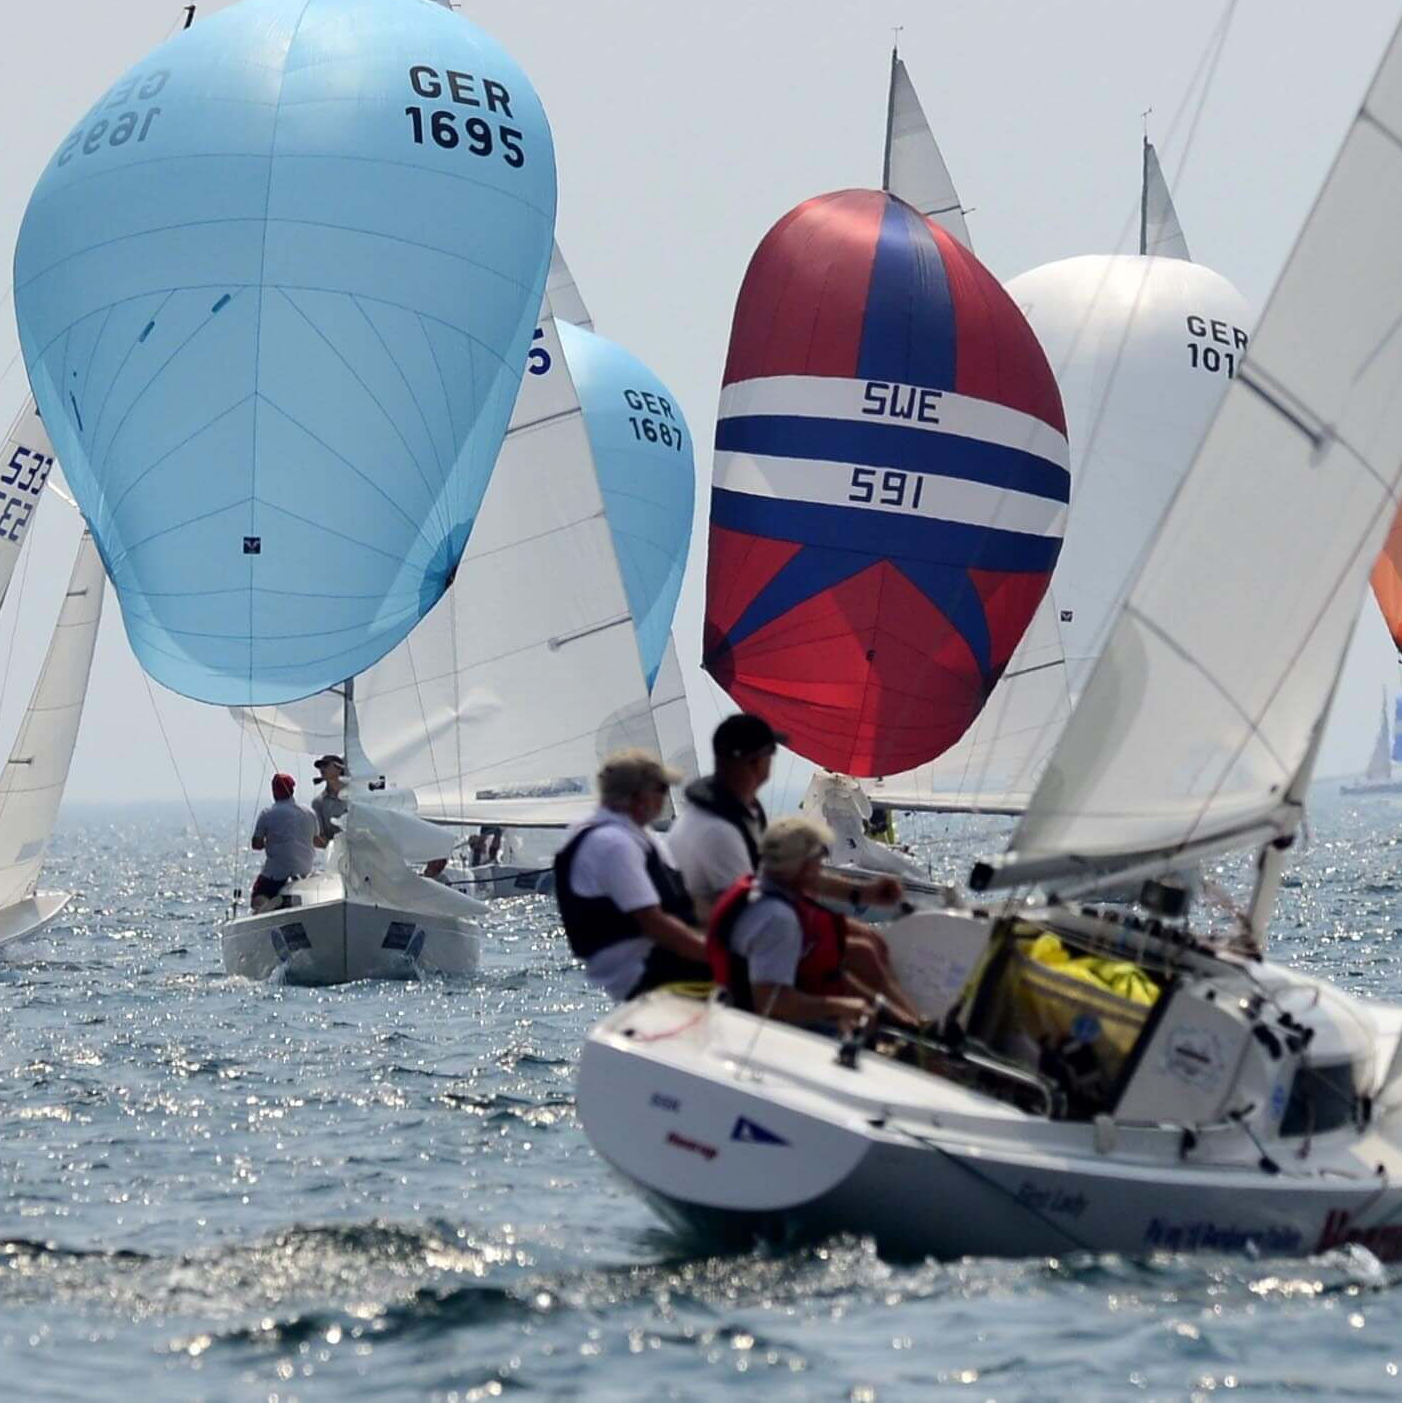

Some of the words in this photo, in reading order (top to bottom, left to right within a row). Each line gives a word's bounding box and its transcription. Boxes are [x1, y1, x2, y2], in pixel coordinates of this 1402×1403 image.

[409, 65, 513, 119] GER
[405, 106, 525, 168] 1695
[1187, 316, 1248, 350] GER
[623, 390, 675, 420] GER
[629, 417, 682, 452] 1687
[1, 446, 53, 495] 533
[849, 468, 924, 508] 591
